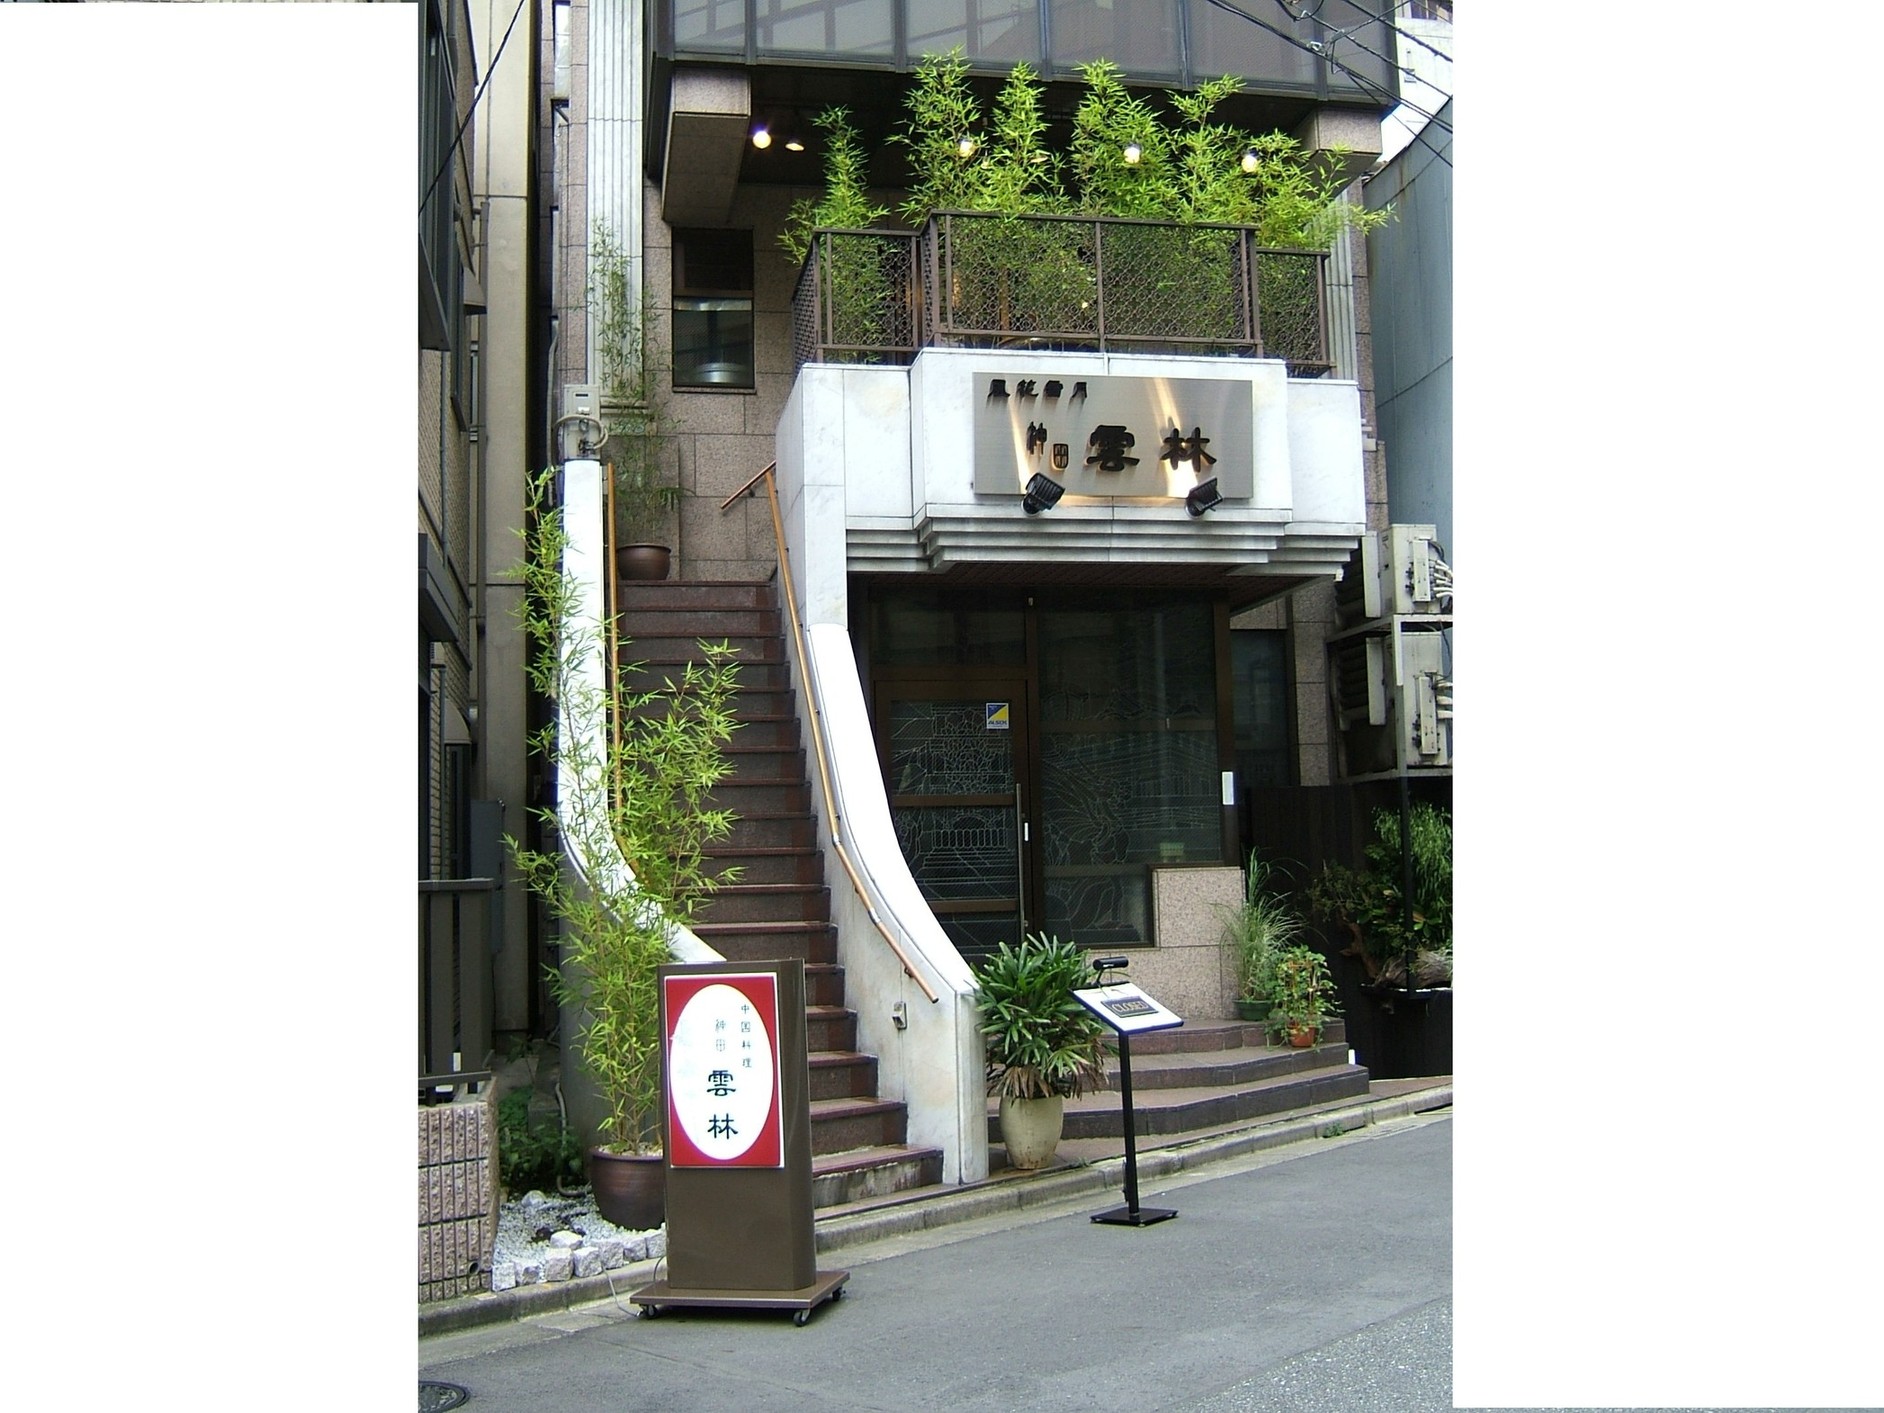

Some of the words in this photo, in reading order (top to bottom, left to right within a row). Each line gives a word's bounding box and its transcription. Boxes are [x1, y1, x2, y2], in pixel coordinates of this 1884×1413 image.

[1086, 425, 1217, 472] 雲林
[1112, 1001, 1149, 1013] CLOSED
[715, 1019, 727, 1052] 神田
[740, 1003, 753, 1069] 中国料理
[706, 1069, 739, 1140] 雲林
